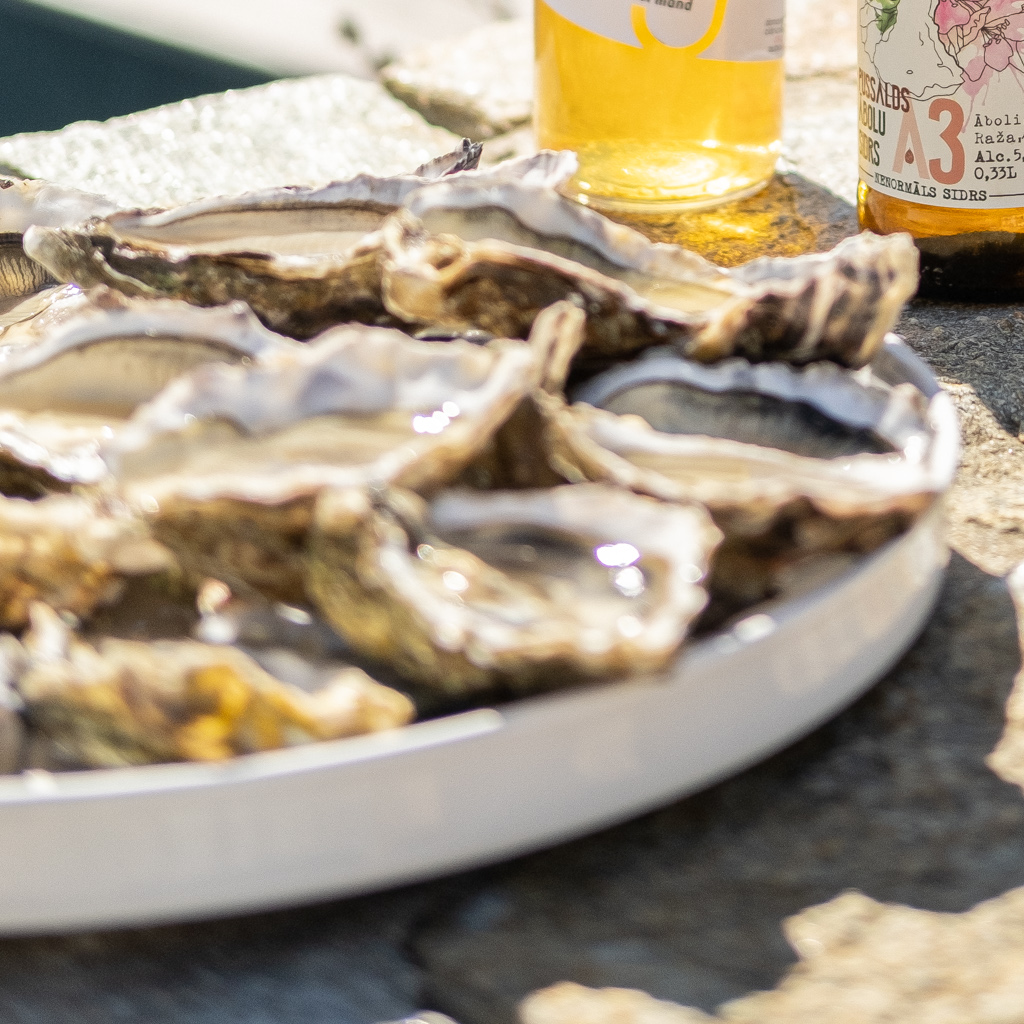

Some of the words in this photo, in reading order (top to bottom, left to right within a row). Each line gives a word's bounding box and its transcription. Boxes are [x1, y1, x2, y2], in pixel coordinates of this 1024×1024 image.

[892, 97, 965, 185] A3
[974, 150, 1011, 163] Alc.
[974, 166, 1017, 181] 0,33L
[943, 188, 987, 202] SIDRS
